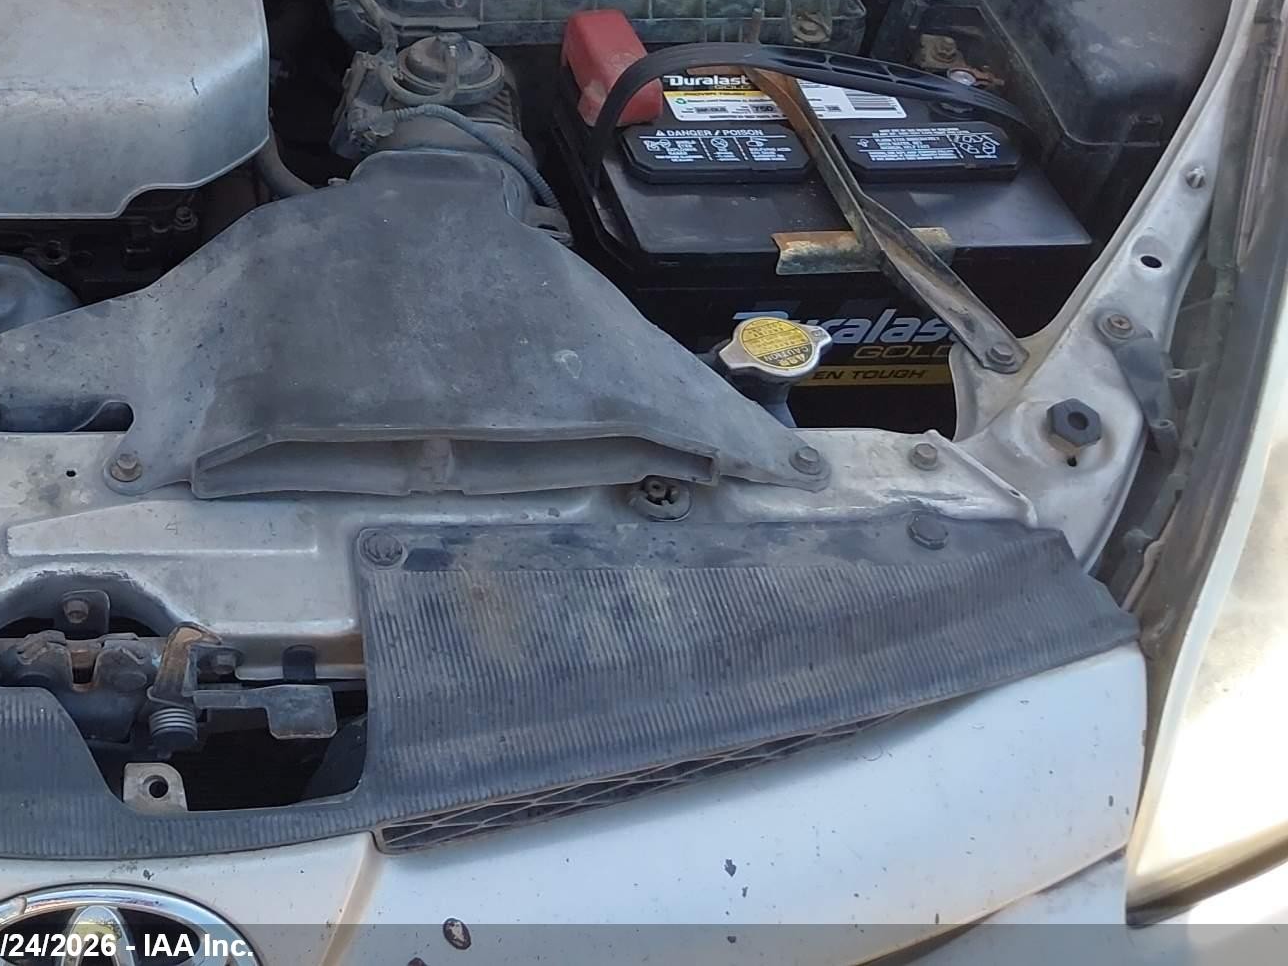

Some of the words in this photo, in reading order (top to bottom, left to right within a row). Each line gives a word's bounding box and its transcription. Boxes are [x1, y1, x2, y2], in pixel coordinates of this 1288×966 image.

[664, 75, 750, 87] Duralast
[764, 346, 809, 362] CAUTION
[852, 369, 927, 380] TOUGH
